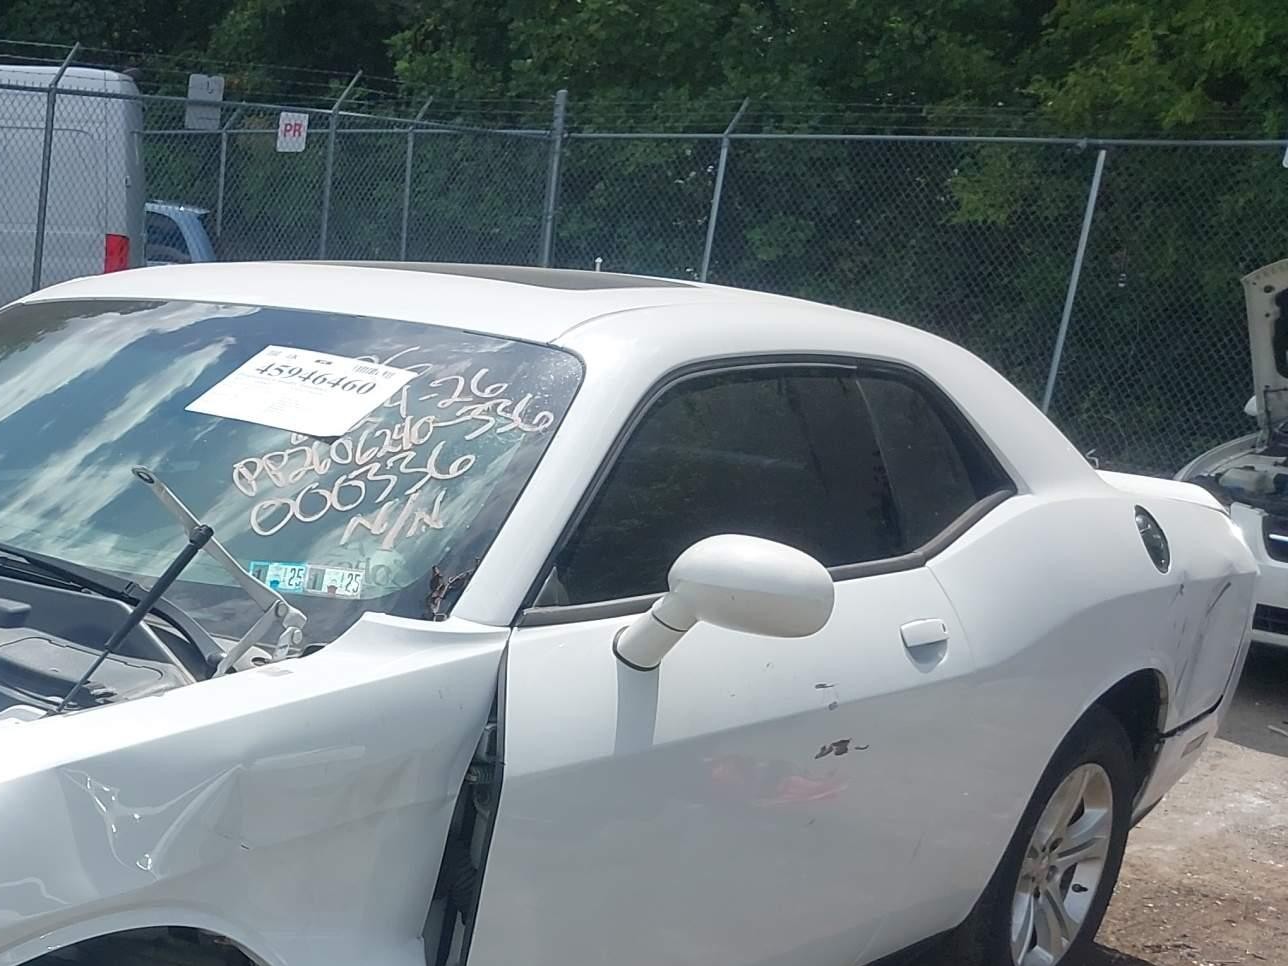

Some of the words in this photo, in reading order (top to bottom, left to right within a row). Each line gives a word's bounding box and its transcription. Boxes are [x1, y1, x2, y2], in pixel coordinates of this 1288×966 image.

[283, 122, 303, 138] PR
[255, 362, 377, 395] 45946460
[250, 440, 477, 537] 000336
[288, 567, 304, 587] 25
[345, 572, 362, 593] 25
